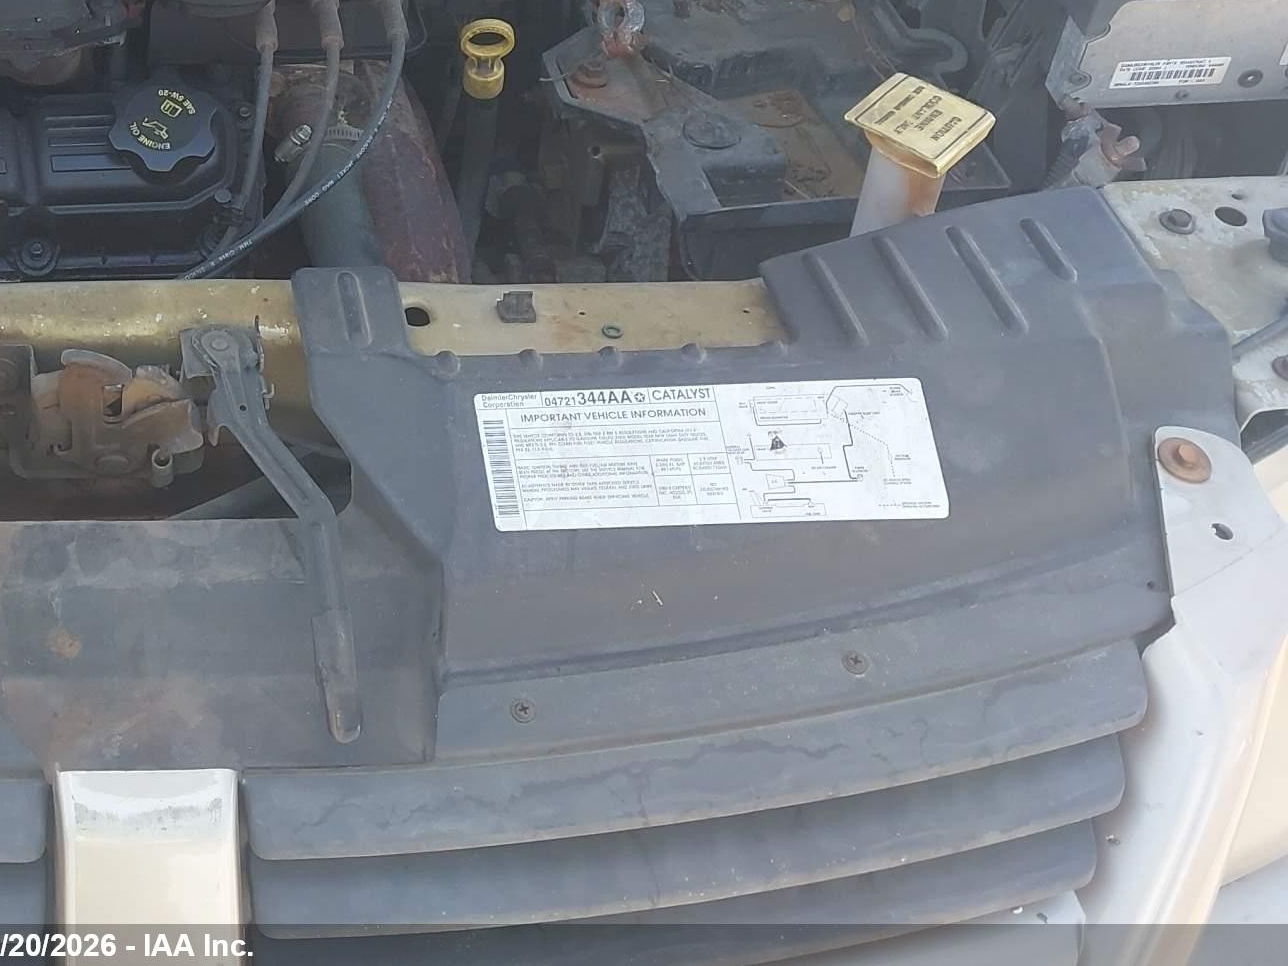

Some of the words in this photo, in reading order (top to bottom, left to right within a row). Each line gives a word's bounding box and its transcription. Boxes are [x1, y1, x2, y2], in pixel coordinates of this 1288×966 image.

[182, 99, 196, 115] SAE
[913, 95, 943, 120] COOLANT
[914, 109, 943, 131] ENGINE
[129, 121, 141, 136] OIL
[931, 116, 962, 141] CAUTION
[137, 135, 170, 150] ENGINE
[481, 393, 537, 401] DaimlerChrysler
[544, 390, 633, 407] 04721344AA
[652, 388, 711, 401] CATALYST
[483, 401, 525, 409] Corporation
[520, 411, 583, 423] IMPORTANT
[584, 410, 627, 421] VEHICLE
[630, 408, 706, 419] INFORMATION
